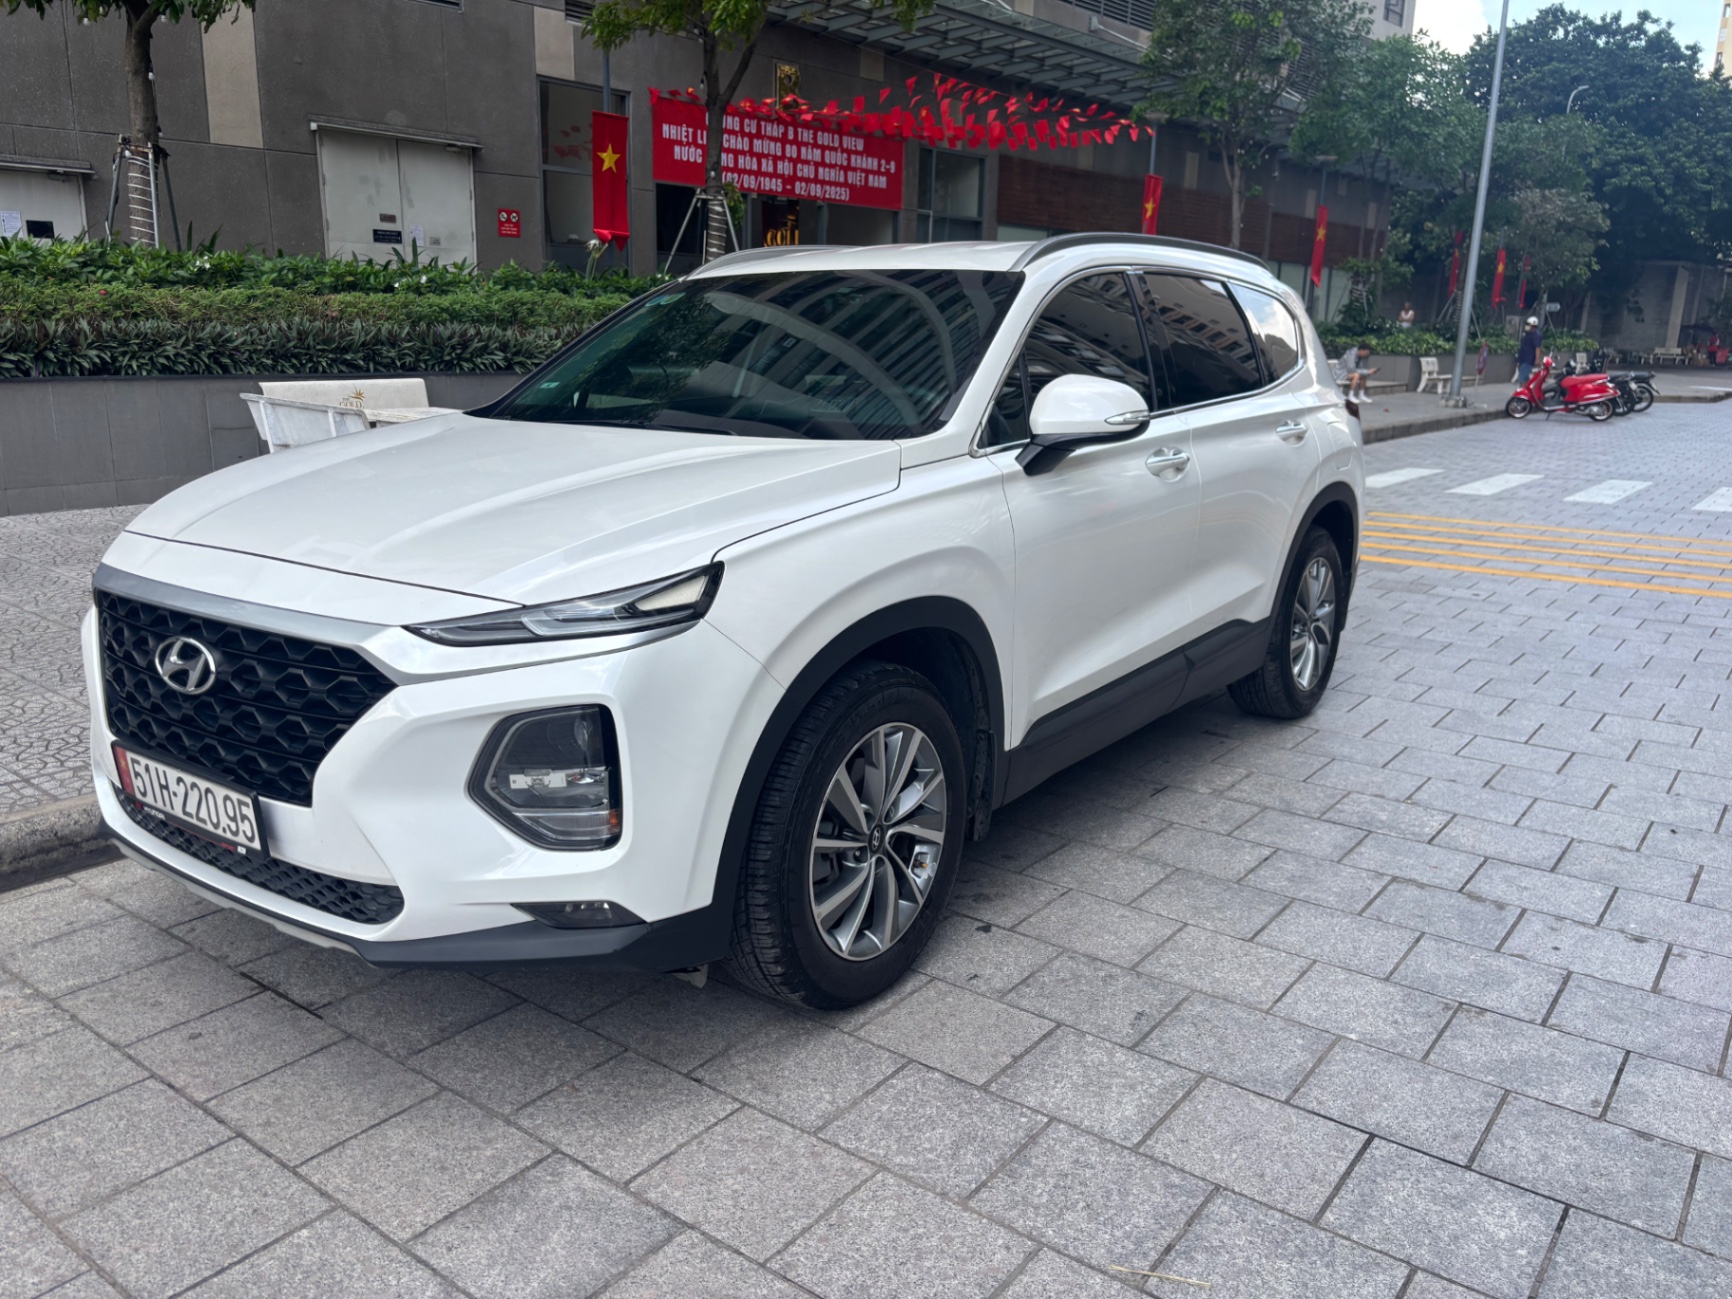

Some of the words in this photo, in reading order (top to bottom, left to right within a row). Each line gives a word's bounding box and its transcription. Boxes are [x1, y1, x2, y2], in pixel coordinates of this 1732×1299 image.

[662, 123, 694, 144] NHIỆT
[722, 132, 749, 152] CHÀO
[753, 137, 782, 157] MỪNG
[785, 144, 797, 159] 80
[800, 145, 822, 162] NĂM
[824, 147, 848, 167] QUỐC
[850, 153, 878, 172] KHÁNH
[743, 117, 757, 134] CƯ
[760, 120, 785, 138] THÁP
[787, 126, 794, 140] B
[797, 127, 814, 144] THE
[817, 130, 840, 148] GOLD
[842, 135, 864, 152] VIEW
[674, 144, 703, 163] NƯỚC
[738, 152, 758, 172] HÒA
[761, 156, 774, 174] XÃ
[777, 159, 793, 178] HỘI
[796, 161, 815, 179] CHỦ
[818, 166, 845, 183] NGHĨA
[847, 169, 866, 189] VIỆT
[868, 174, 886, 190] NAM
[794, 180, 850, 202] 02/09/2025)
[130, 757, 256, 844] 51H-220.95
